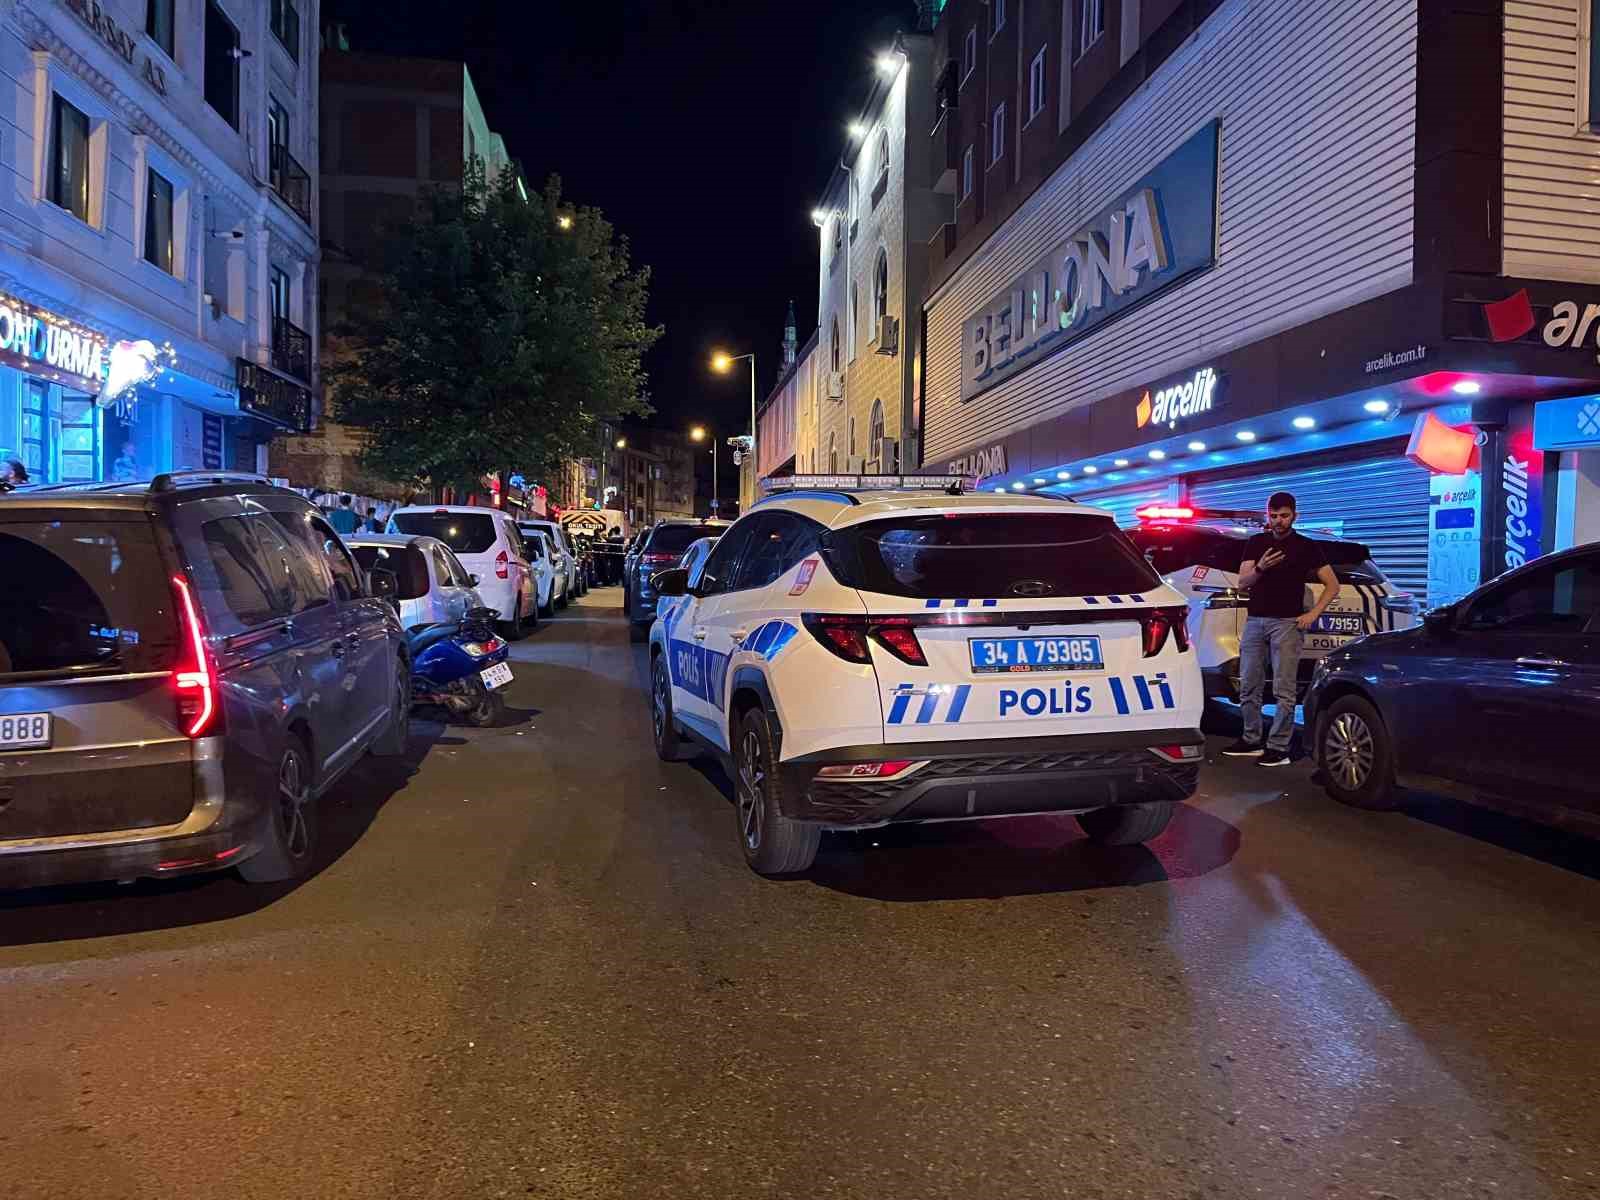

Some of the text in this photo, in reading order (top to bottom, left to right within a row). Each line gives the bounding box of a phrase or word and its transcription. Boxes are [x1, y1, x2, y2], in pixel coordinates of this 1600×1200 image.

[969, 188, 1169, 378] BELLONA
[1543, 301, 1600, 365] ar
[1365, 344, 1426, 372] arcelik.com.tr
[1151, 367, 1216, 429] arçelik
[1503, 455, 1532, 569] arçelik
[1328, 617, 1359, 630] 79153
[678, 648, 699, 687] POLİS
[984, 639, 1093, 664] 34 A 79385
[1000, 680, 1092, 716] POLİS
[2, 717, 44, 740] 888
